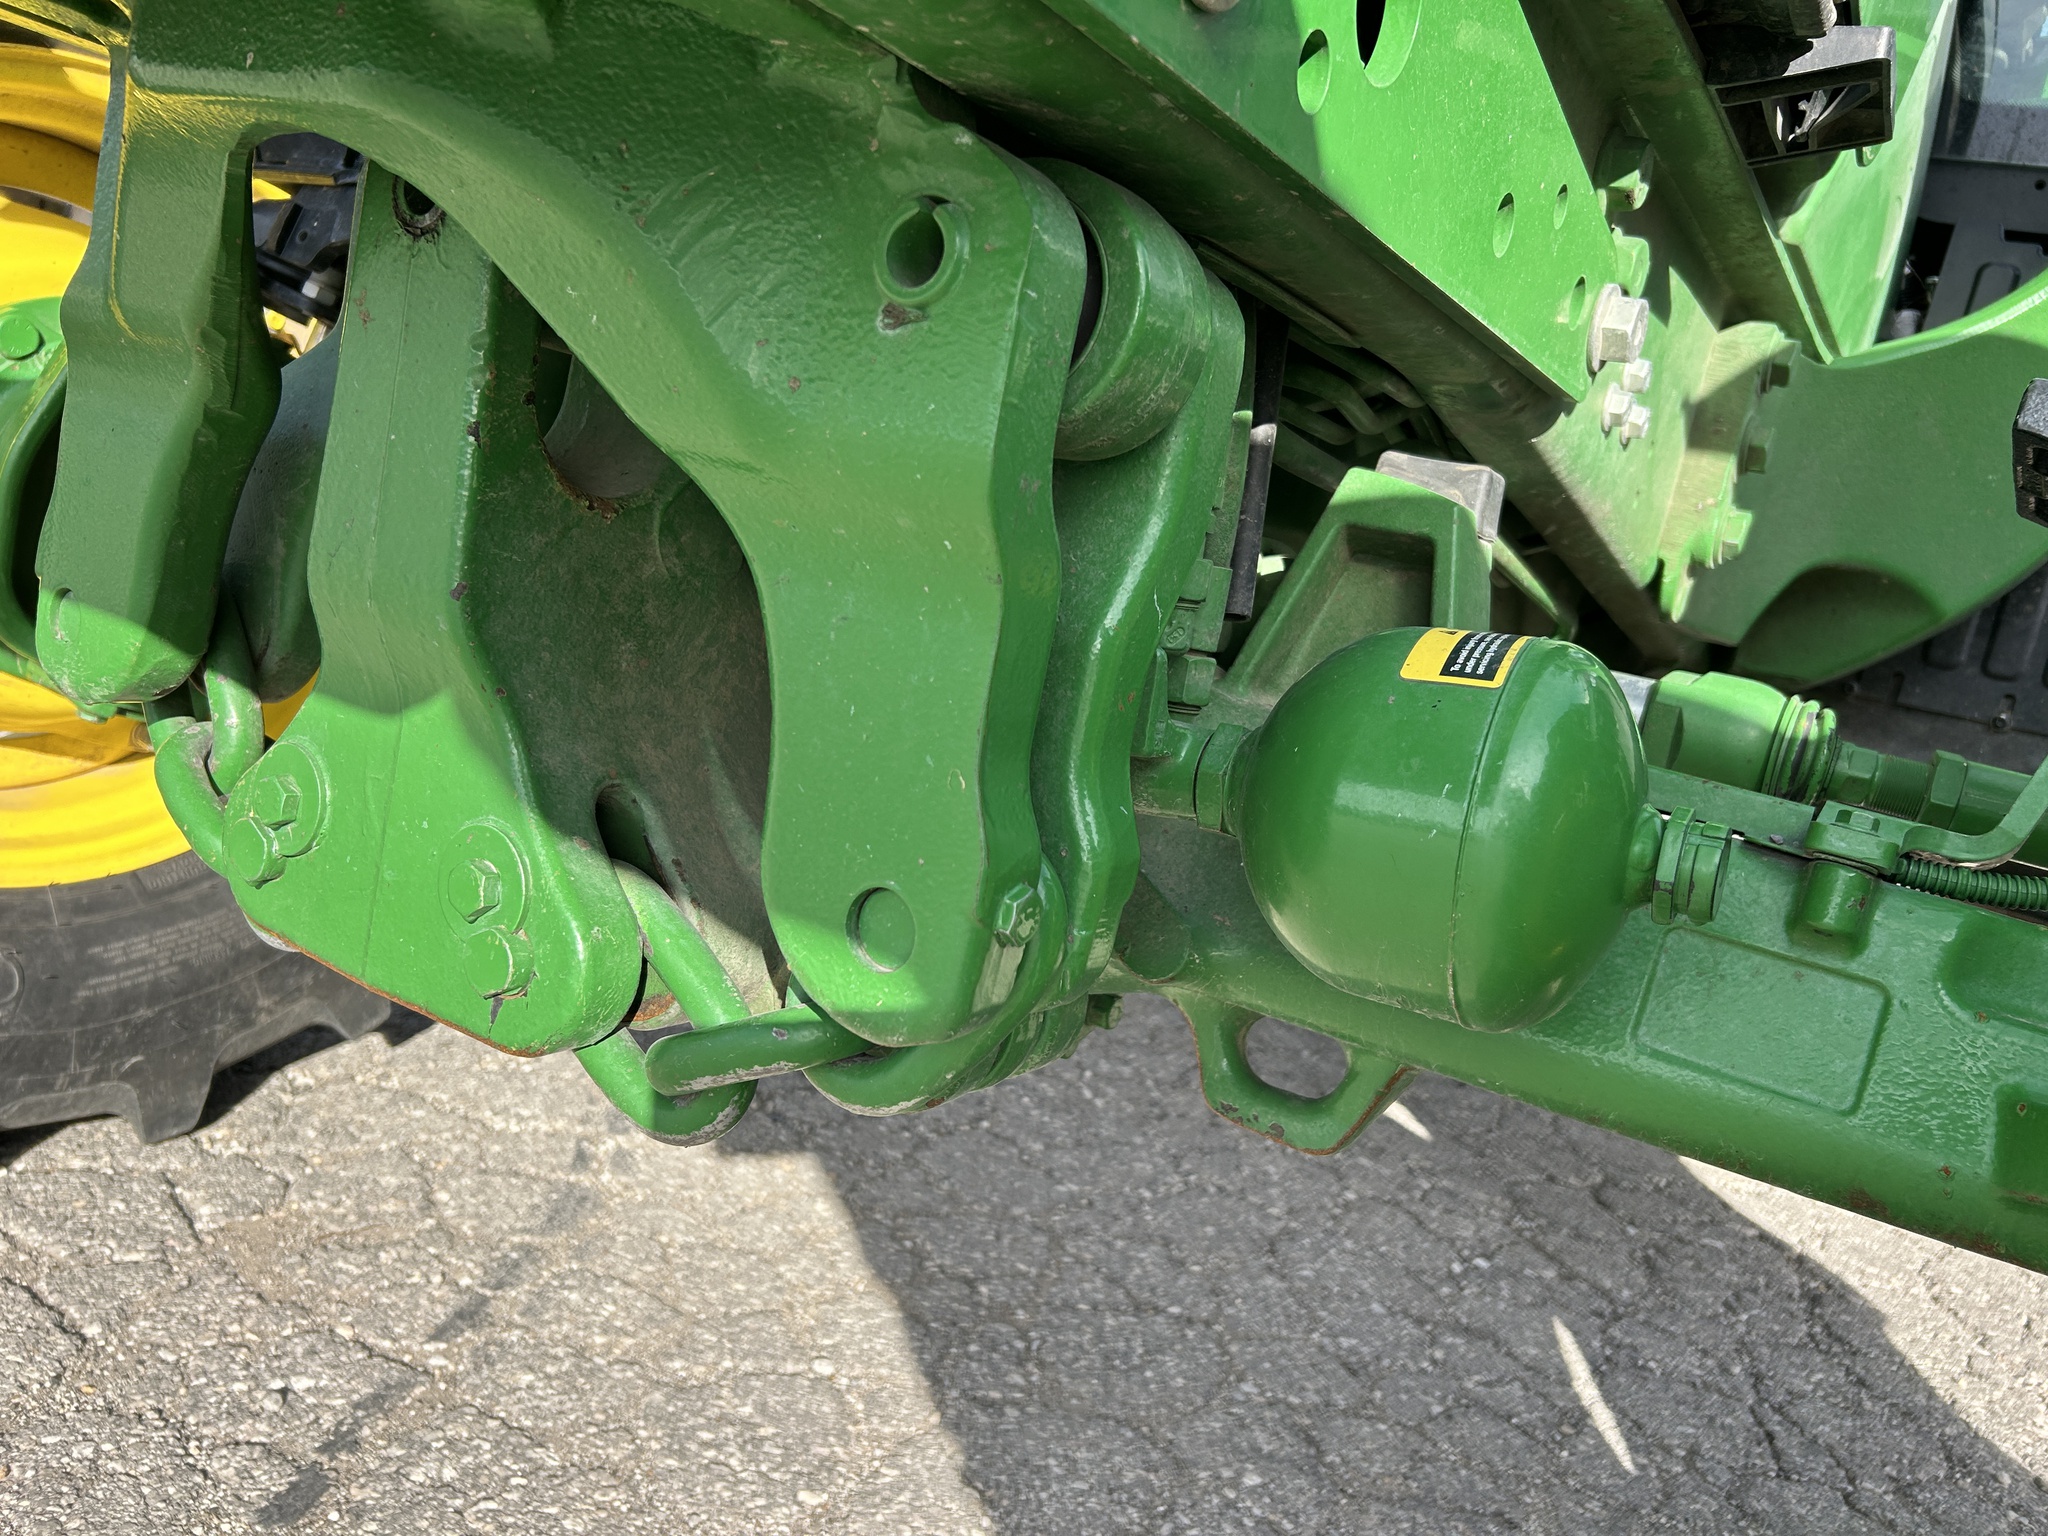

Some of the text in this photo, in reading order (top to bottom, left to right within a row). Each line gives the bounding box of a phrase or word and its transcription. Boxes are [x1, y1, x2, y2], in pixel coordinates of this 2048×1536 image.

[1450, 664, 1461, 672] To
[1456, 650, 1469, 663] avoid
[1464, 658, 1476, 673] under
[1476, 653, 1494, 674] servicing
